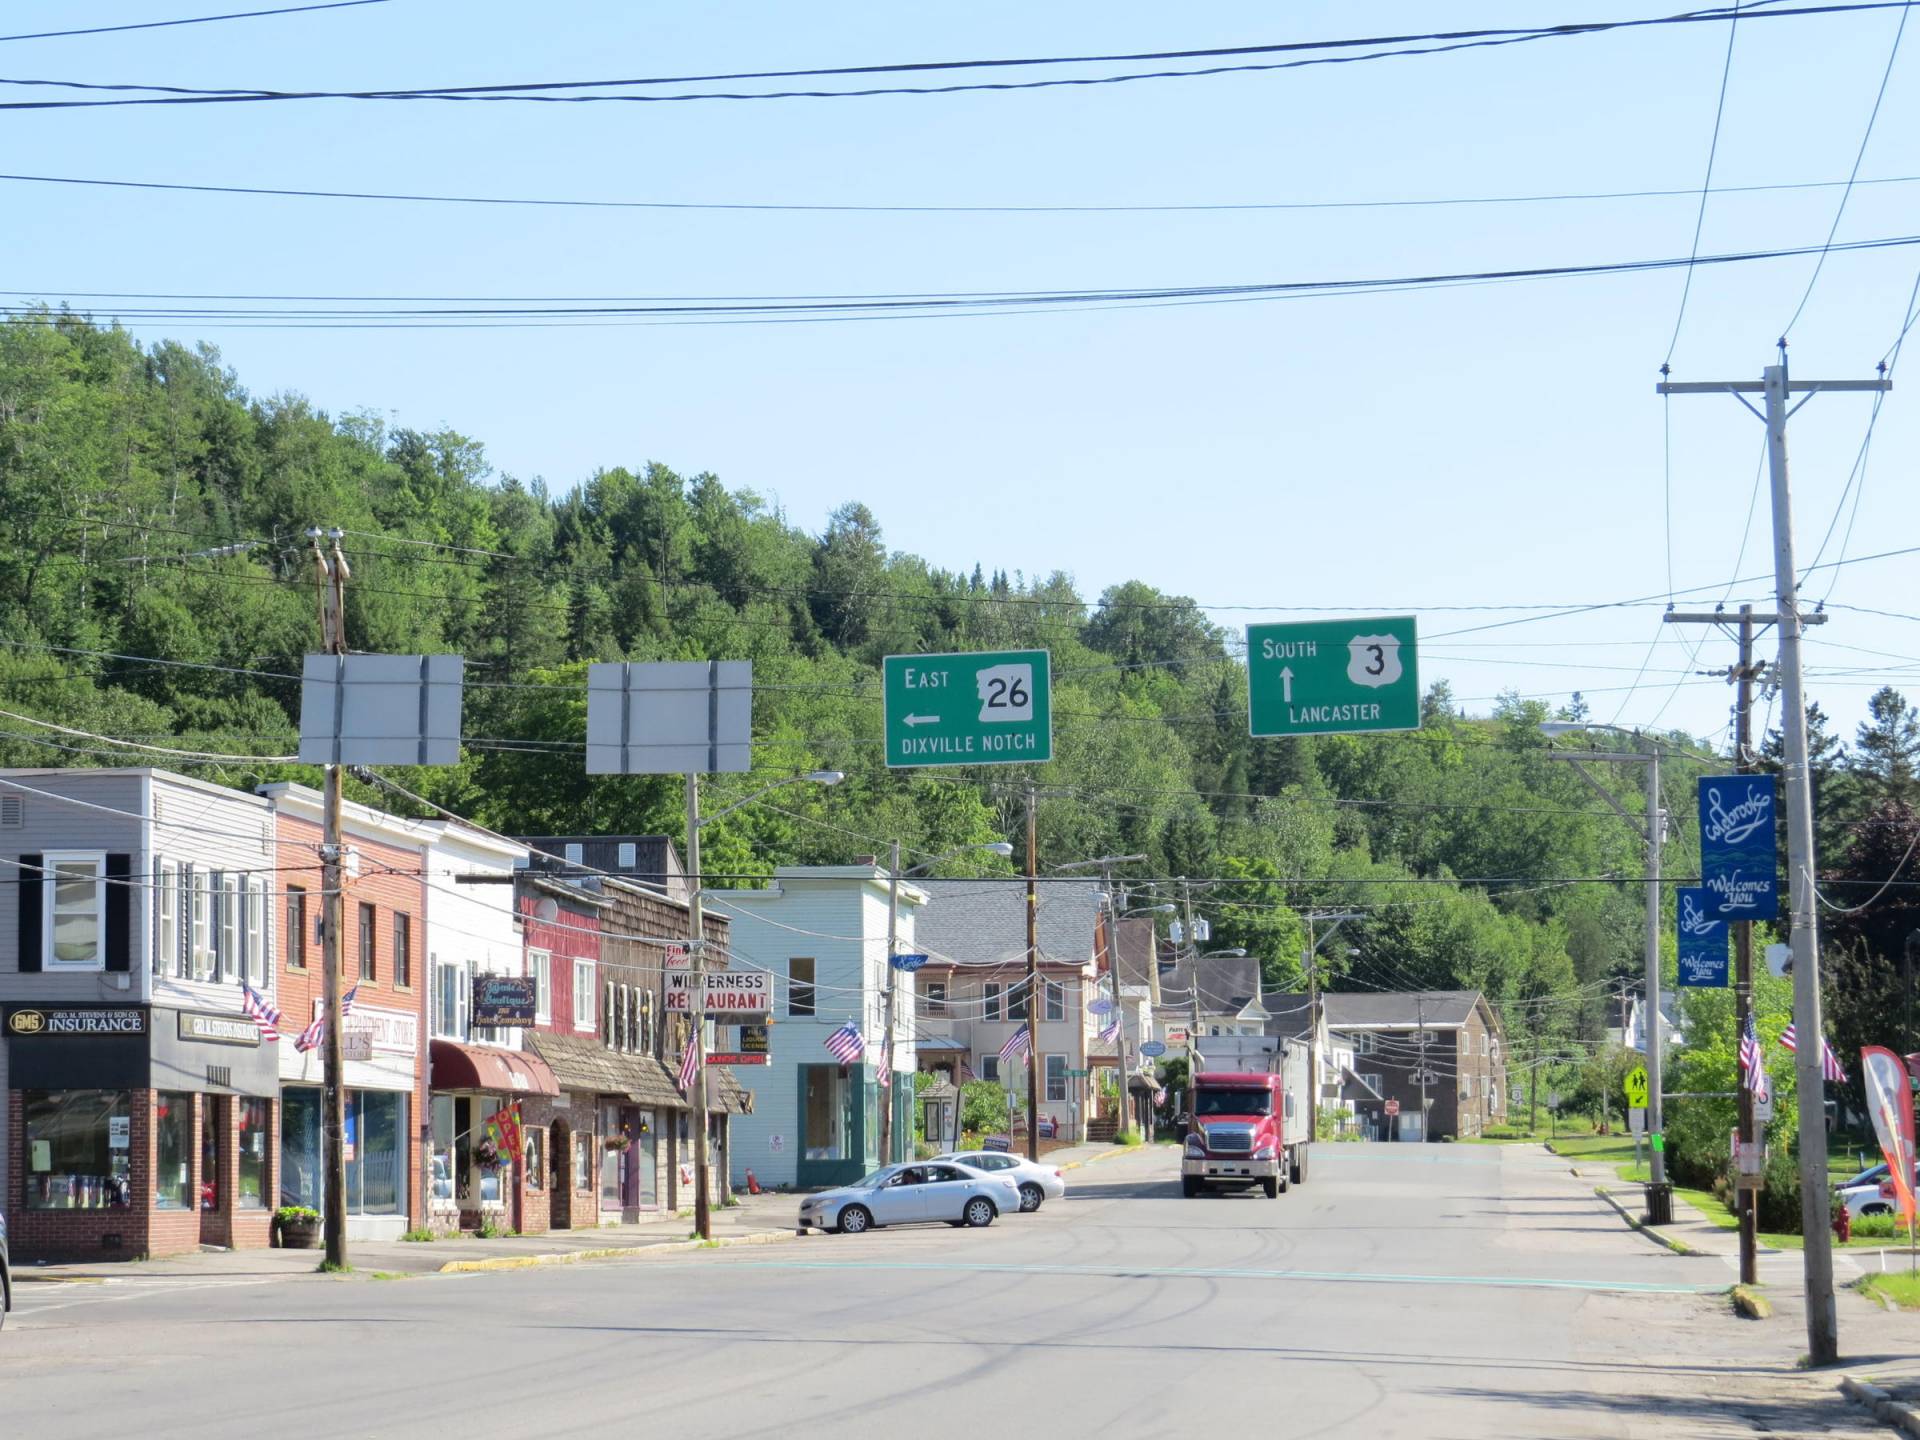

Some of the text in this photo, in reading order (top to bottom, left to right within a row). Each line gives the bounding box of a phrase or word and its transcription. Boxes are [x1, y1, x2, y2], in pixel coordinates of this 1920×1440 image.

[1262, 638, 1317, 660] SOUTH
[1364, 644, 1385, 676] 3
[904, 668, 949, 689] EAST
[987, 677, 1029, 708] 26
[1289, 703, 1380, 724] LANCASTER
[902, 733, 1036, 755] DIXVILLE NOTCH
[1707, 869, 1771, 893] Welcomes
[1718, 892, 1758, 913] You
[1681, 952, 1725, 969] Welcomes
[672, 975, 763, 989] WIERNESS
[1688, 967, 1716, 982] You
[667, 993, 767, 1009] REAURANT
[15, 1014, 39, 1030] GMS
[48, 1018, 142, 1032] INSURANCE
[114, 1011, 128, 1019] SON
[740, 1055, 765, 1064] OPEN
[498, 1109, 521, 1160] OPEN
